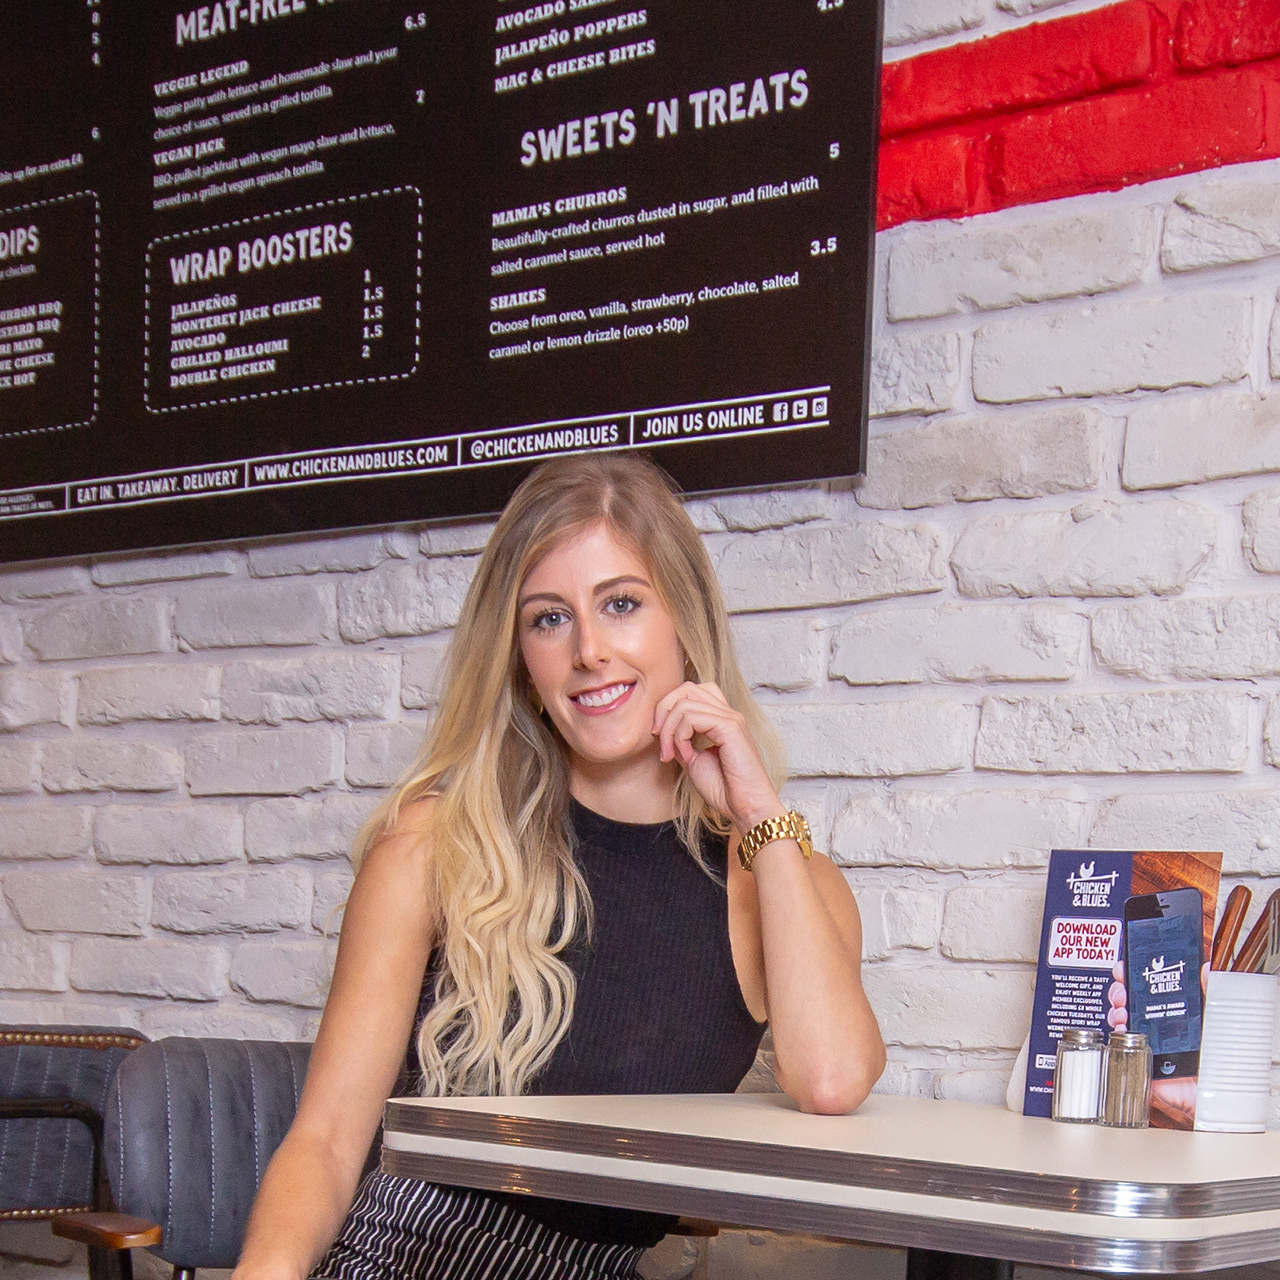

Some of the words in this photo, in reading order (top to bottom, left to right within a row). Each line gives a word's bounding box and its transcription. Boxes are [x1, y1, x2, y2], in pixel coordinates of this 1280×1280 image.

[404, 13, 426, 30] 6.5
[496, 0, 565, 32] AVOCADO
[91, 32, 100, 45] 5
[495, 30, 570, 66] JALAPEÑO
[574, 10, 647, 41] POPPERS
[154, 75, 197, 96] VEGGIE
[200, 61, 249, 84] LEGEND
[495, 72, 527, 92] MAC
[531, 68, 543, 83] &
[547, 52, 605, 78] CHEESE
[609, 39, 655, 64] BITES
[154, 104, 183, 119] Veggie
[184, 97, 206, 113] patty
[207, 90, 227, 104] with
[228, 83, 259, 99] lettuce
[260, 75, 278, 90] and
[279, 62, 330, 85] homemade
[332, 58, 353, 70] slaw
[355, 50, 373, 66] and
[375, 47, 397, 64] your
[154, 126, 182, 140] choice
[181, 121, 194, 133] of
[222, 105, 253, 122] served
[252, 104, 264, 115] in
[270, 92, 300, 113] grilled
[301, 85, 333, 102] tortilla
[521, 109, 636, 166] SWEETS
[647, 98, 678, 138] 'N
[689, 70, 808, 129] TREATS
[91, 127, 100, 140] 6
[154, 146, 193, 165] VEGAN
[195, 138, 225, 159] JACK
[201, 158, 239, 179] jackfruit
[239, 152, 260, 167] with
[261, 147, 289, 162] vegan
[290, 141, 315, 155] mayo
[317, 136, 340, 148] slaw
[339, 128, 358, 143] and
[829, 143, 840, 158] 5
[199, 182, 228, 202] grilled
[227, 178, 256, 193] vegan
[256, 167, 292, 187] spinach
[293, 160, 324, 177] tortilla
[555, 187, 627, 213] CHURROS
[492, 220, 590, 251] Beautifully-crafted
[592, 215, 635, 231] churros
[637, 203, 676, 223] dusted
[679, 202, 691, 215] in
[693, 197, 728, 213] sugar,
[731, 188, 754, 205] and
[757, 181, 788, 200] filled
[791, 176, 819, 193] with
[170, 247, 232, 285] WRAP
[238, 222, 352, 272] BOOSTERS
[491, 258, 523, 276] salted
[524, 249, 567, 269] caramel
[569, 246, 603, 260] sauce,
[606, 235, 643, 254] served
[645, 232, 665, 247] hot
[810, 237, 837, 256] 3.5
[363, 268, 371, 282] 1
[363, 286, 384, 301] 1.5
[490, 288, 546, 311] SHAKES
[490, 319, 529, 335] Choose
[531, 314, 557, 327] from
[559, 310, 586, 322] oreo,
[589, 301, 628, 318] vanilla,
[632, 292, 695, 311] strawberry,
[698, 281, 759, 300] chocolate,
[763, 272, 799, 290] salted
[39, 301, 62, 315] BBQ
[171, 294, 237, 320] JALAPEÑOS
[171, 312, 237, 334] MONTEREY
[239, 306, 270, 325] JACK
[273, 296, 321, 316] CHEESE
[363, 305, 384, 320] 1.5
[37, 318, 60, 332] BBQ
[362, 325, 383, 340] 1.5
[489, 340, 531, 359] caramel
[533, 341, 545, 352] or
[547, 335, 582, 349] lemon
[584, 327, 621, 344] drizzle
[624, 325, 653, 339] (oreo
[656, 315, 689, 333] +50p)
[13, 338, 43, 352] MAYO
[171, 333, 226, 352] AVOCADO
[171, 351, 222, 369] GRILLED
[225, 339, 288, 361] HALLOUMI
[361, 345, 370, 358] 2
[14, 353, 54, 369] CHEESE
[171, 369, 217, 387] DOUBLE
[220, 359, 275, 379] CHICKEN
[14, 372, 36, 385] HOT
[643, 416, 678, 437] JOIN
[683, 413, 703, 432] US
[708, 406, 764, 429] ONLINE
[471, 425, 618, 459] @CHICKENANDBLUES
[255, 446, 447, 480] WWW.CHICKENANDBLUES.COM
[77, 487, 98, 503] EAT
[100, 485, 114, 500] IN.
[117, 477, 180, 498] TAKEAWAY.
[183, 469, 238, 490] DELIVERY
[1073, 882, 1111, 895] CHICKEN
[1057, 922, 1117, 936] DOWNLOAD
[1060, 935, 1083, 947] OUR
[1085, 936, 1111, 948] NEW
[1053, 947, 1073, 959] APP
[1076, 948, 1115, 961] TODAY!
[1149, 971, 1181, 984] CHICKEN
